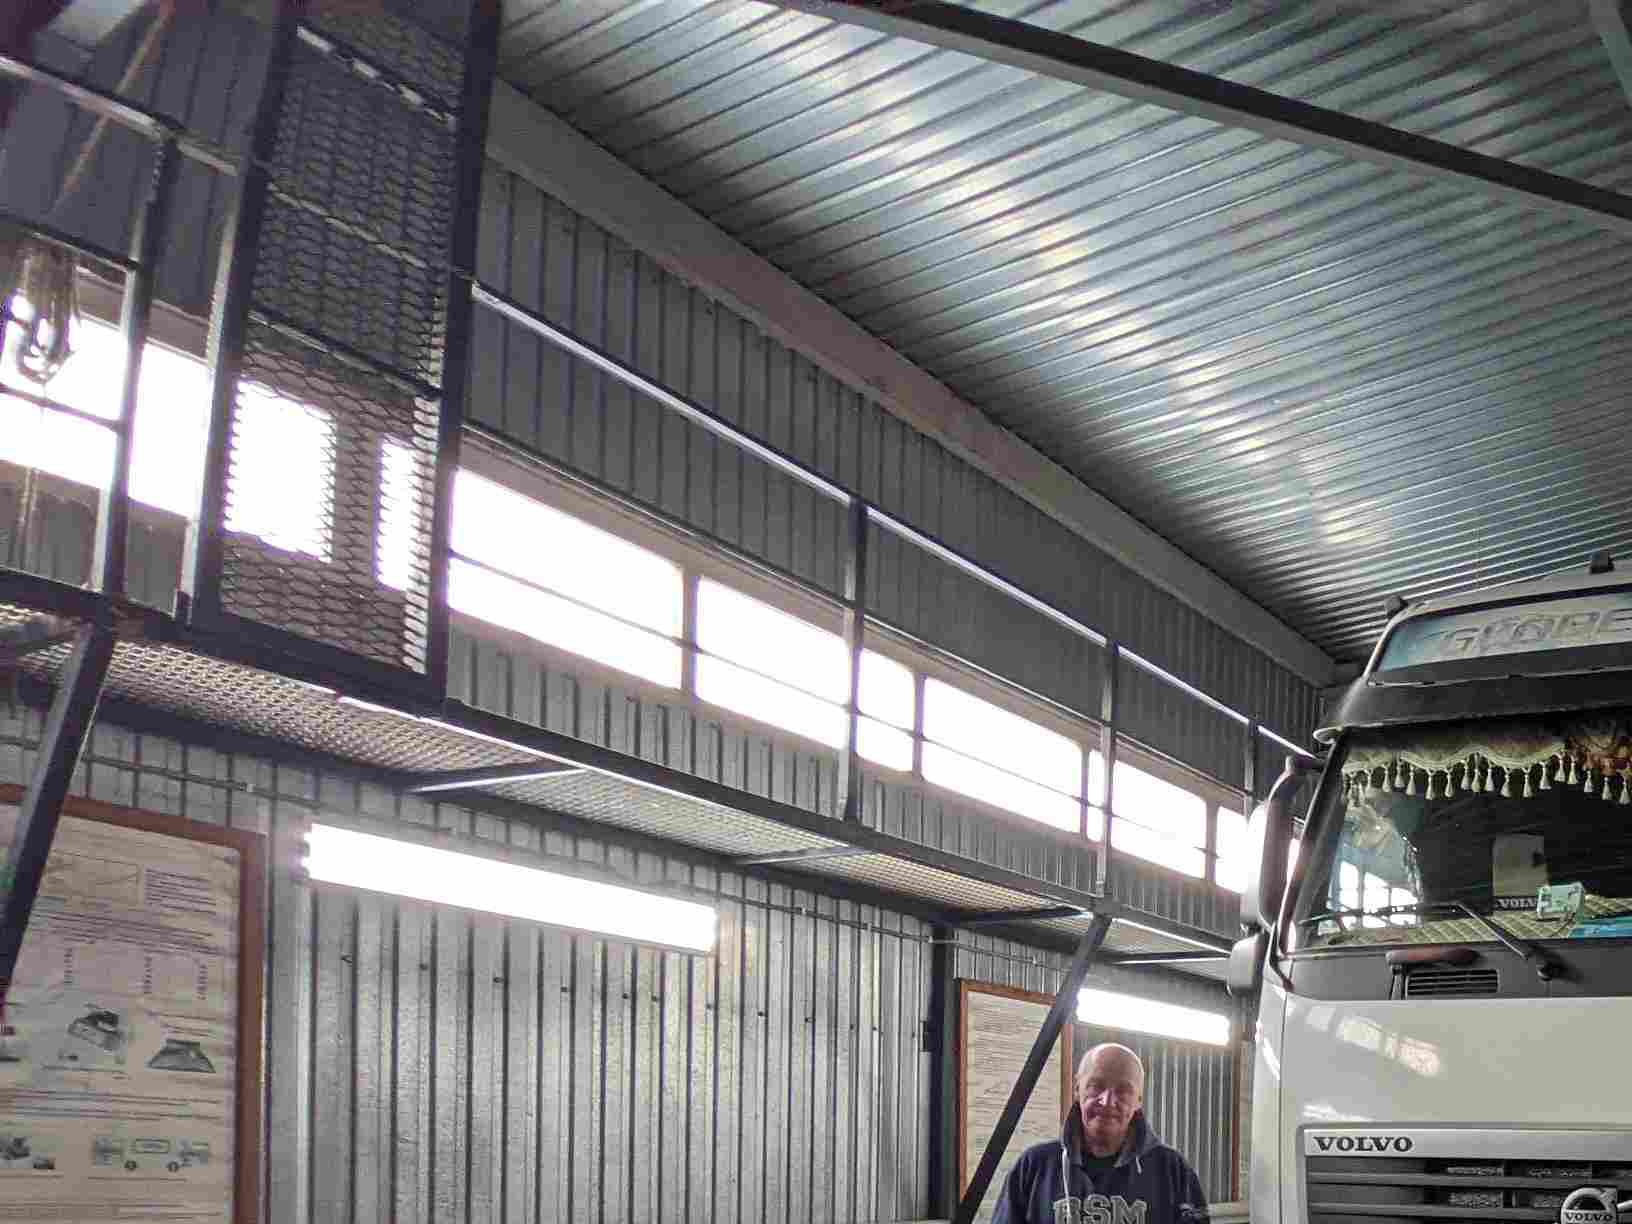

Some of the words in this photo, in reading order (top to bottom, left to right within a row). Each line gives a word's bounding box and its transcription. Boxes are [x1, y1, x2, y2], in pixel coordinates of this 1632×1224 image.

[1499, 897, 1538, 909] VOLV
[1312, 1136, 1413, 1152] VOLVO
[1565, 1212, 1613, 1222] VOLVO
